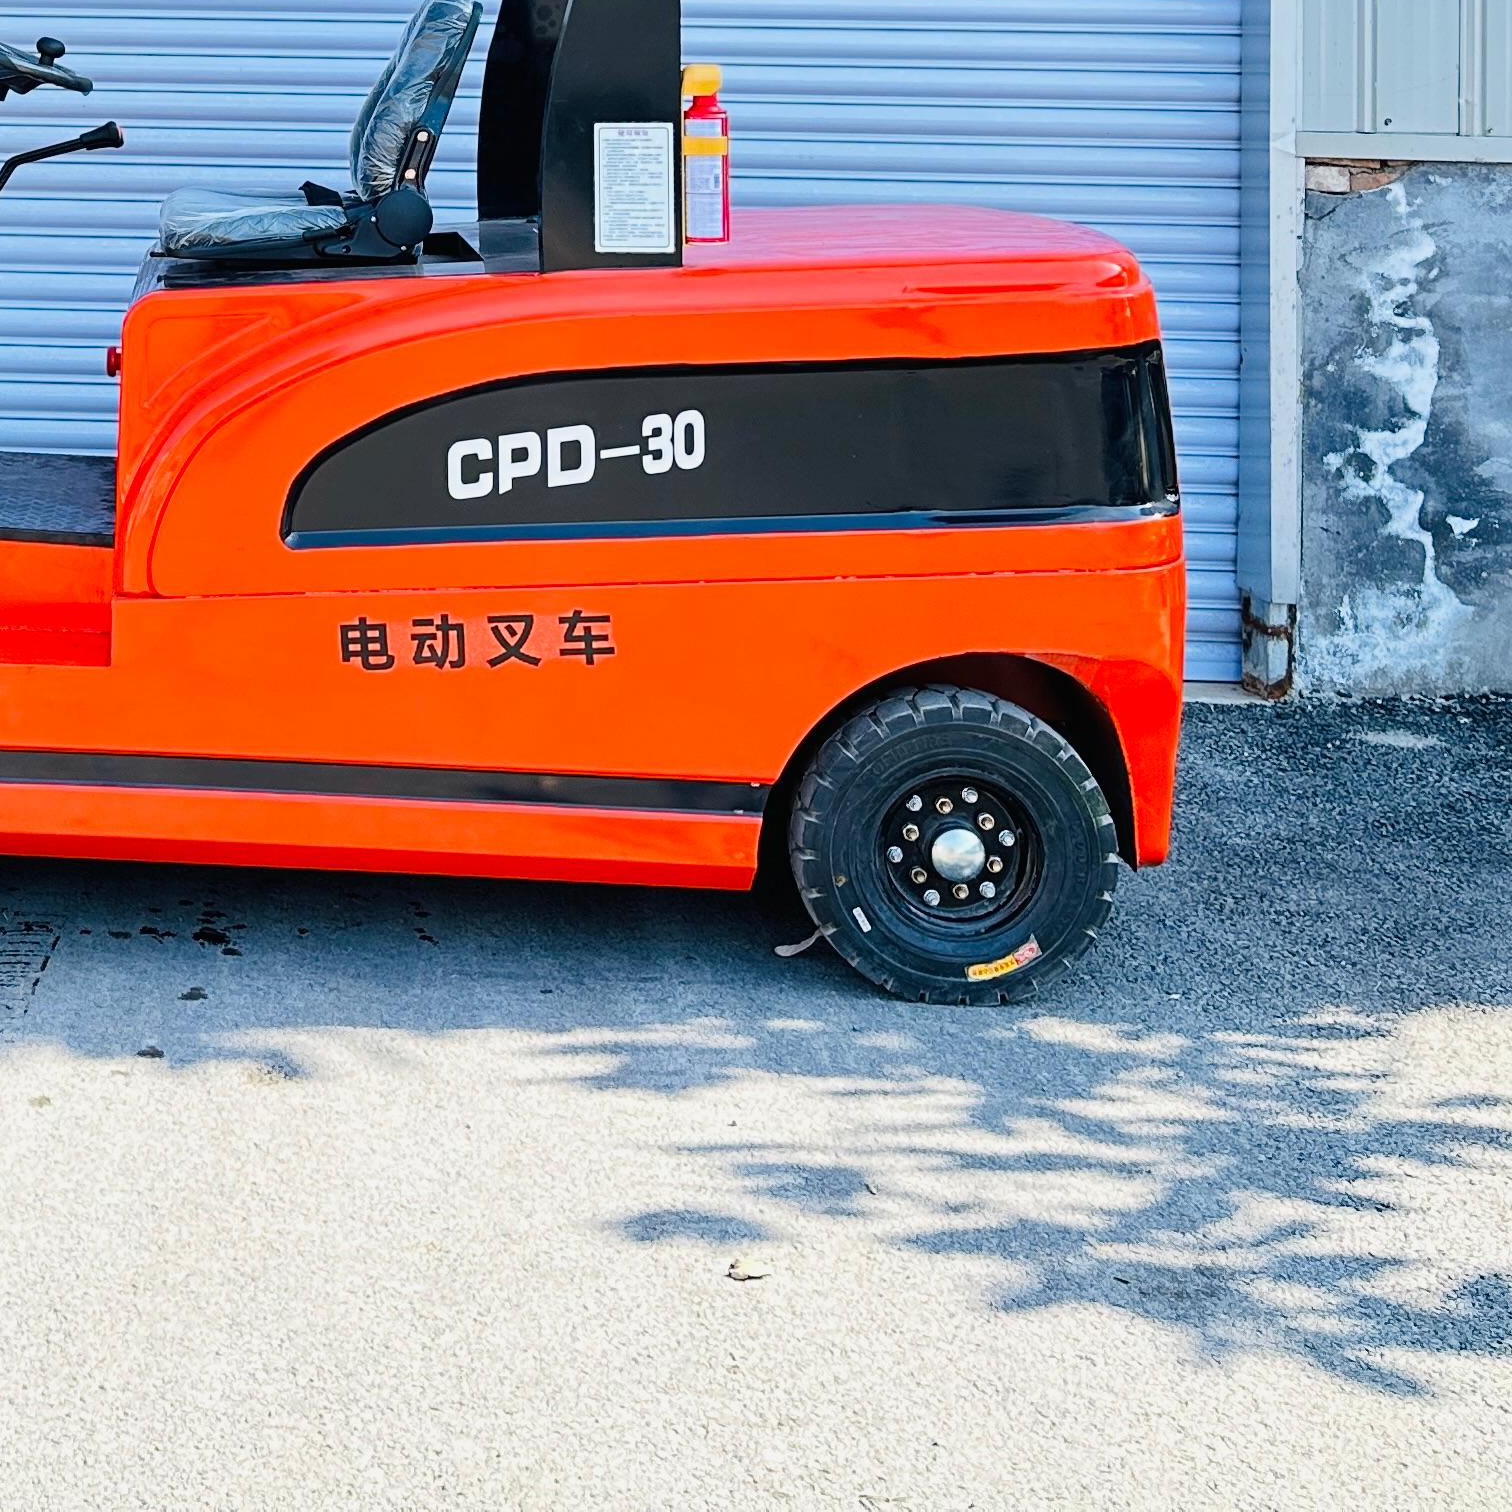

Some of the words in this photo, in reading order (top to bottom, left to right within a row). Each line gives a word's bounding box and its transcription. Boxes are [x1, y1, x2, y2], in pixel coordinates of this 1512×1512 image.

[447, 409, 706, 501] CPD-30
[339, 609, 616, 671] 电动叉车
